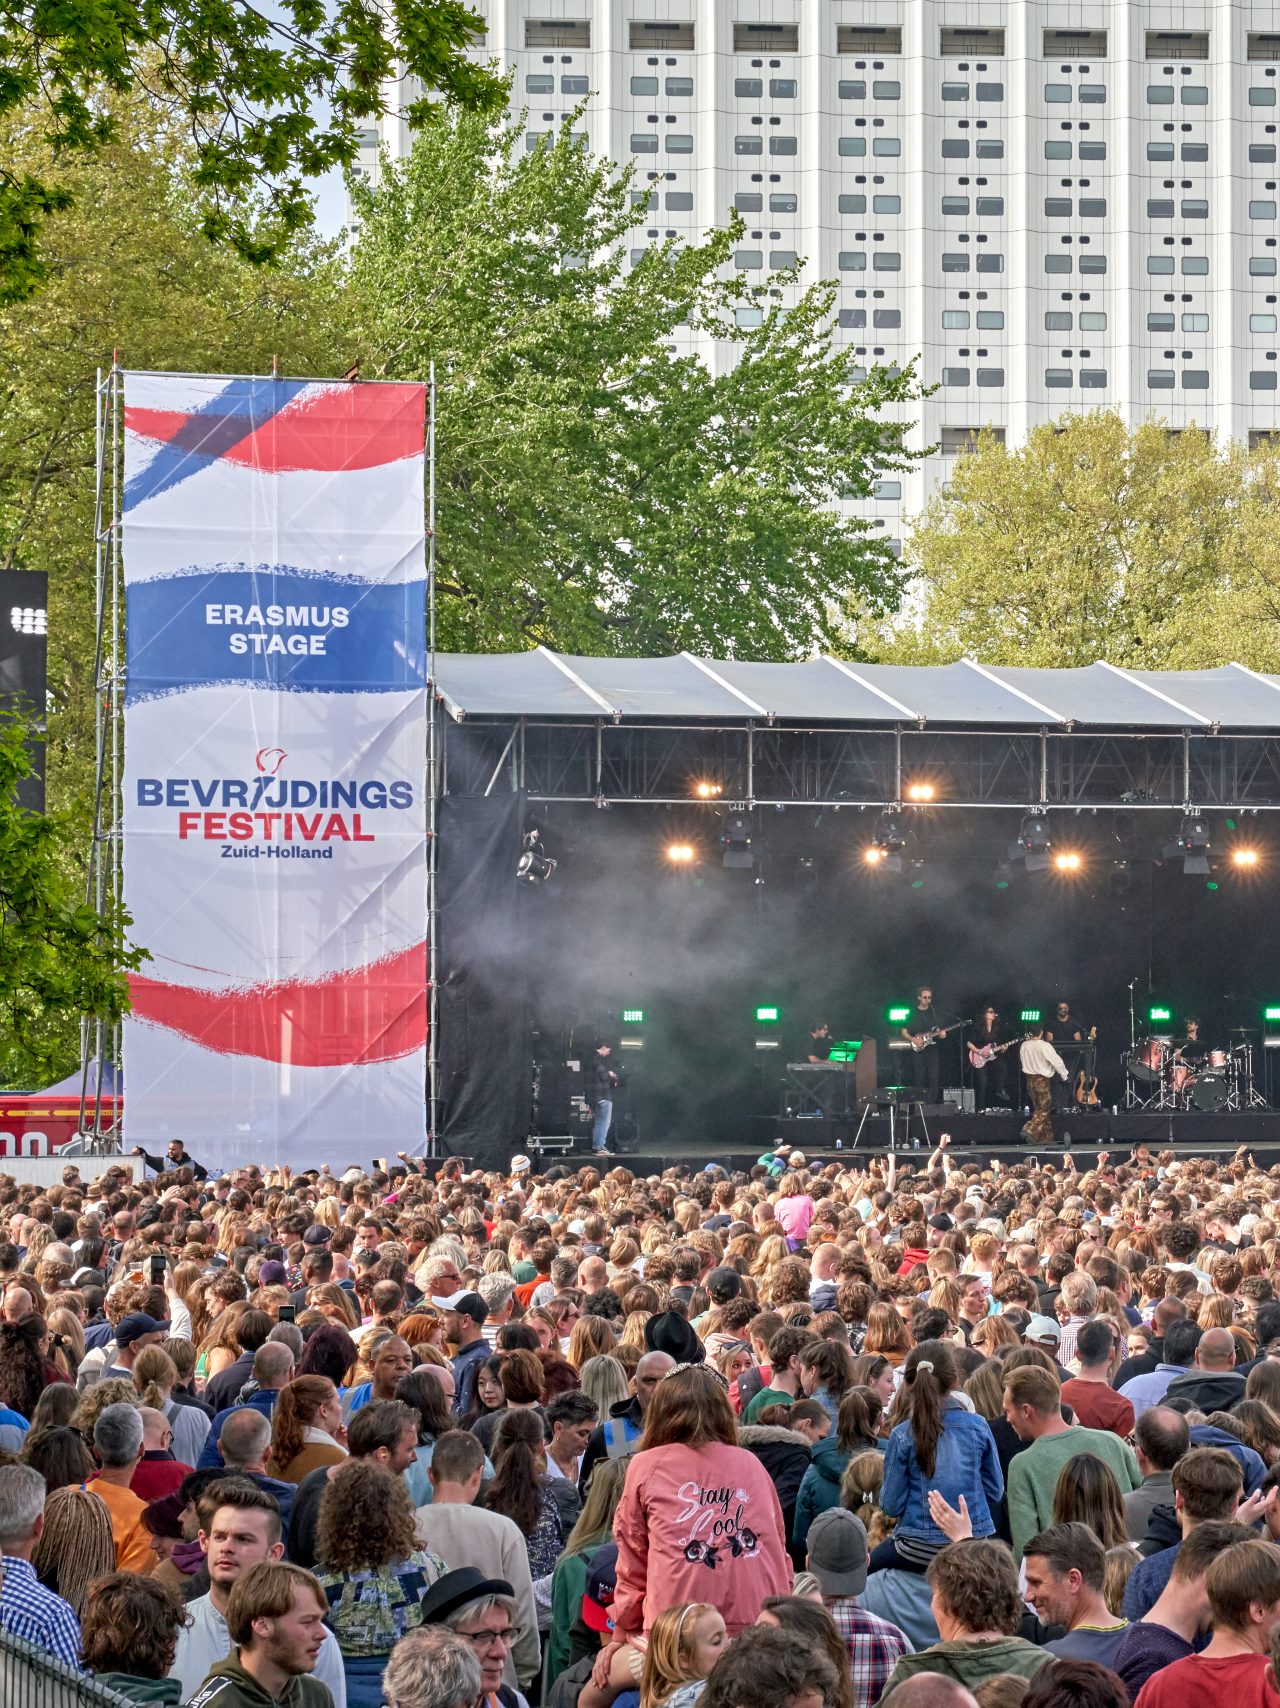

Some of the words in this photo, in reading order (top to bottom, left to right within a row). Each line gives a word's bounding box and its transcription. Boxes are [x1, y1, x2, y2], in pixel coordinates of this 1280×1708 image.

[205, 604, 350, 628] ERASMUS
[229, 633, 327, 656] STAGE
[137, 776, 414, 812] BEVRIJDINGS
[178, 812, 375, 842] FESTIVAL
[221, 845, 333, 860] Zuid-Holland
[675, 1481, 735, 1523] Stay
